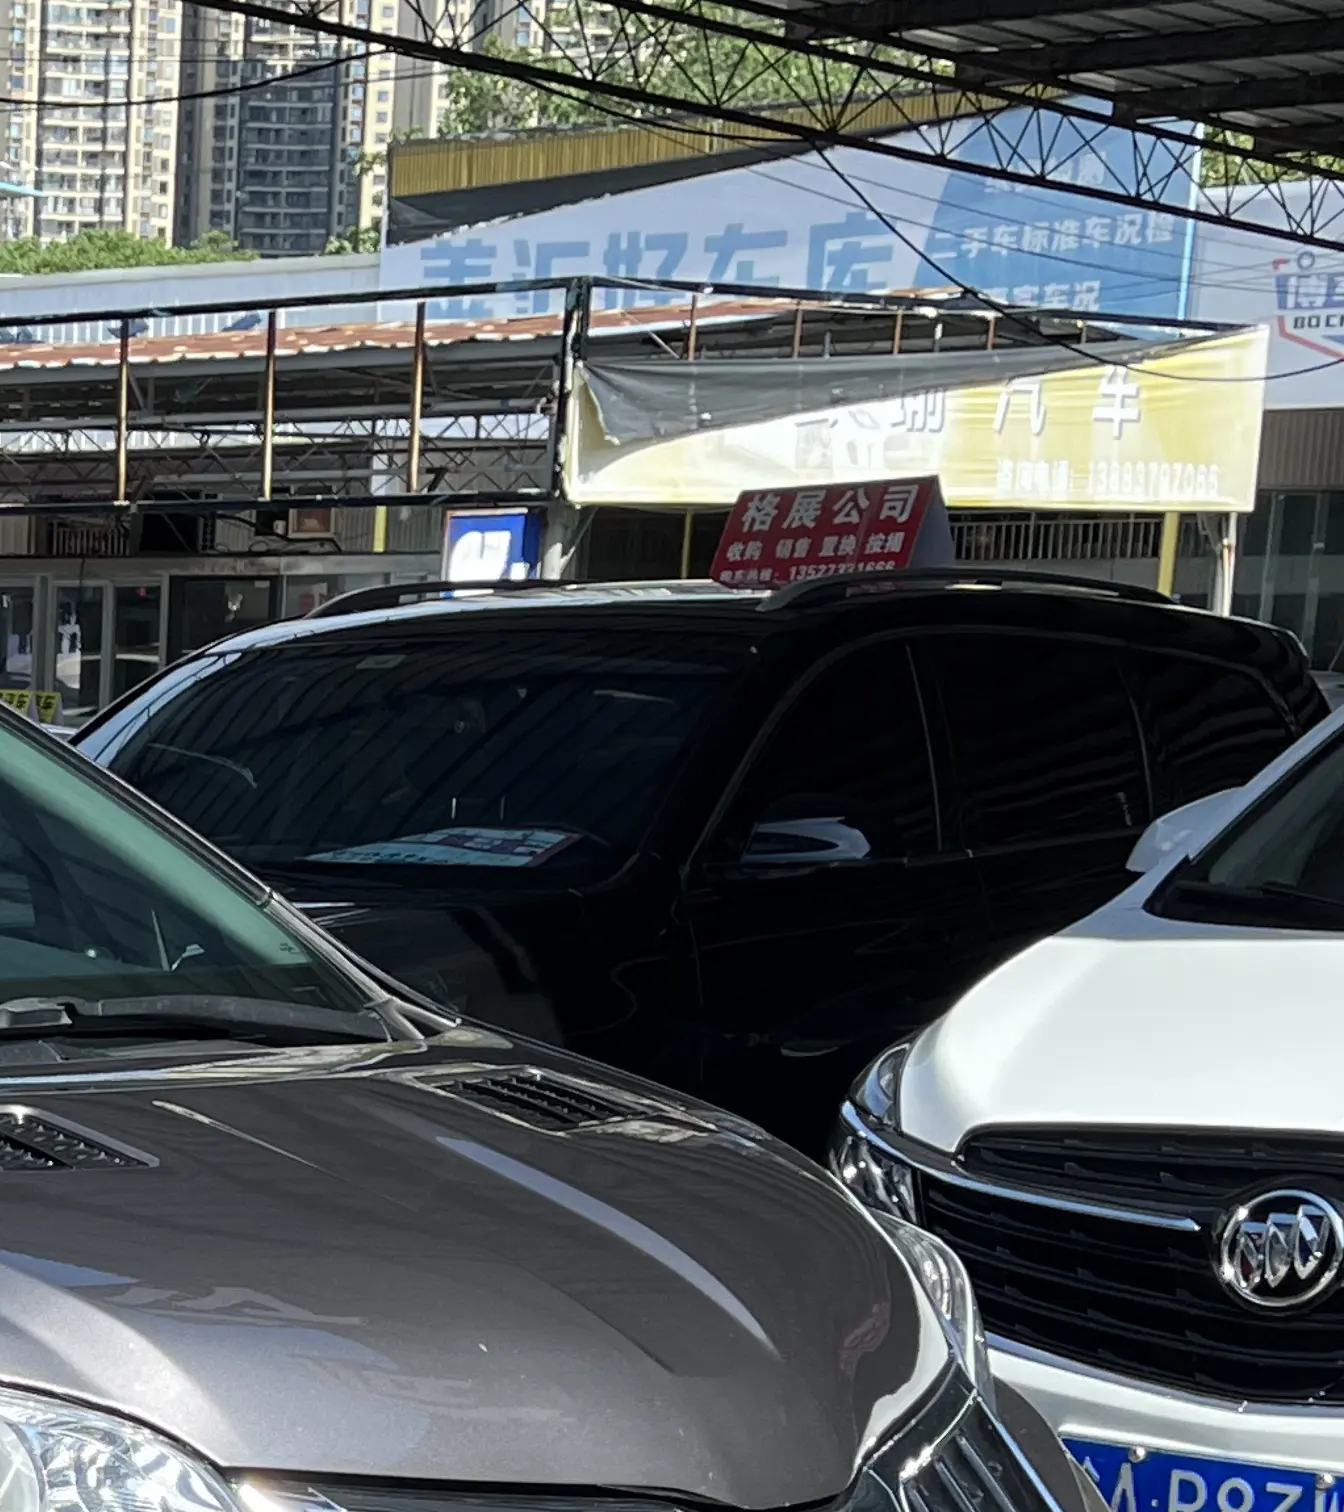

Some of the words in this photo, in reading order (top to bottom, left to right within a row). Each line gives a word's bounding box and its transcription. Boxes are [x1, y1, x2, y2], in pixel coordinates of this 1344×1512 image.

[741, 484, 919, 532] 格展公司
[726, 540, 764, 562] 收购
[775, 536, 812, 559] 销售
[818, 533, 857, 557] 置换
